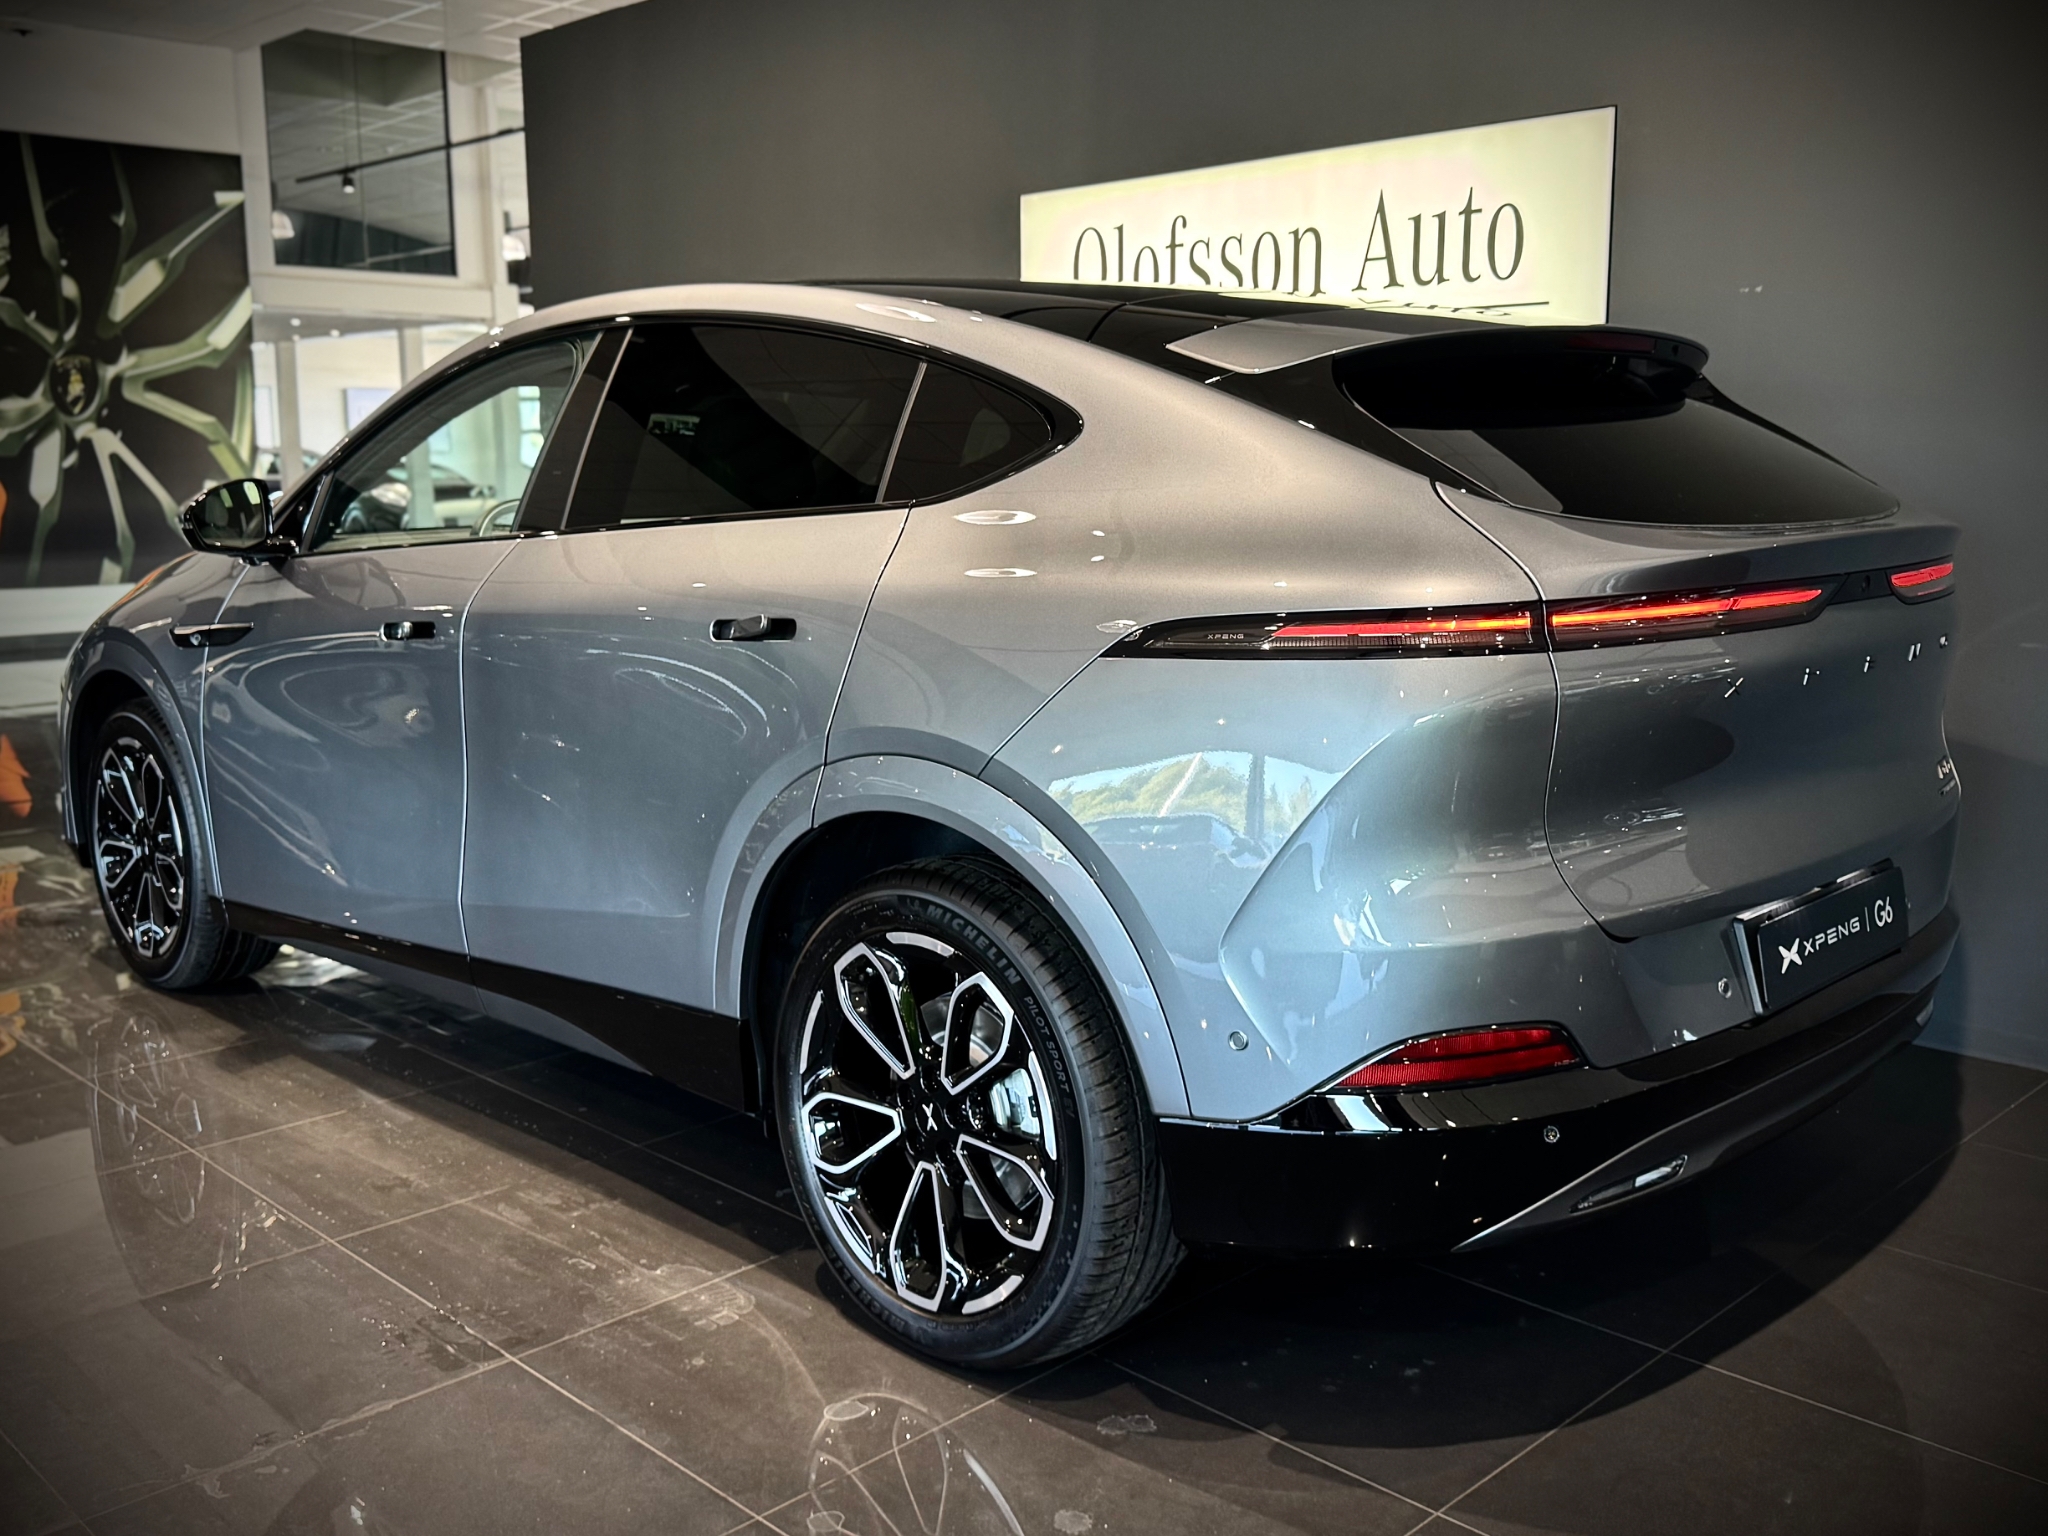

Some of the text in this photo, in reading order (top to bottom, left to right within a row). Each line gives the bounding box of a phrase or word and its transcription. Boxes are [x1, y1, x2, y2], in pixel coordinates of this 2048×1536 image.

[1073, 186, 1524, 297] Olofsson Auto
[1803, 896, 1893, 956] XPENG G6
[926, 905, 1021, 986] MICHELIN
[1023, 996, 1051, 1037] PILOT
[1046, 1040, 1070, 1094] SPORT
